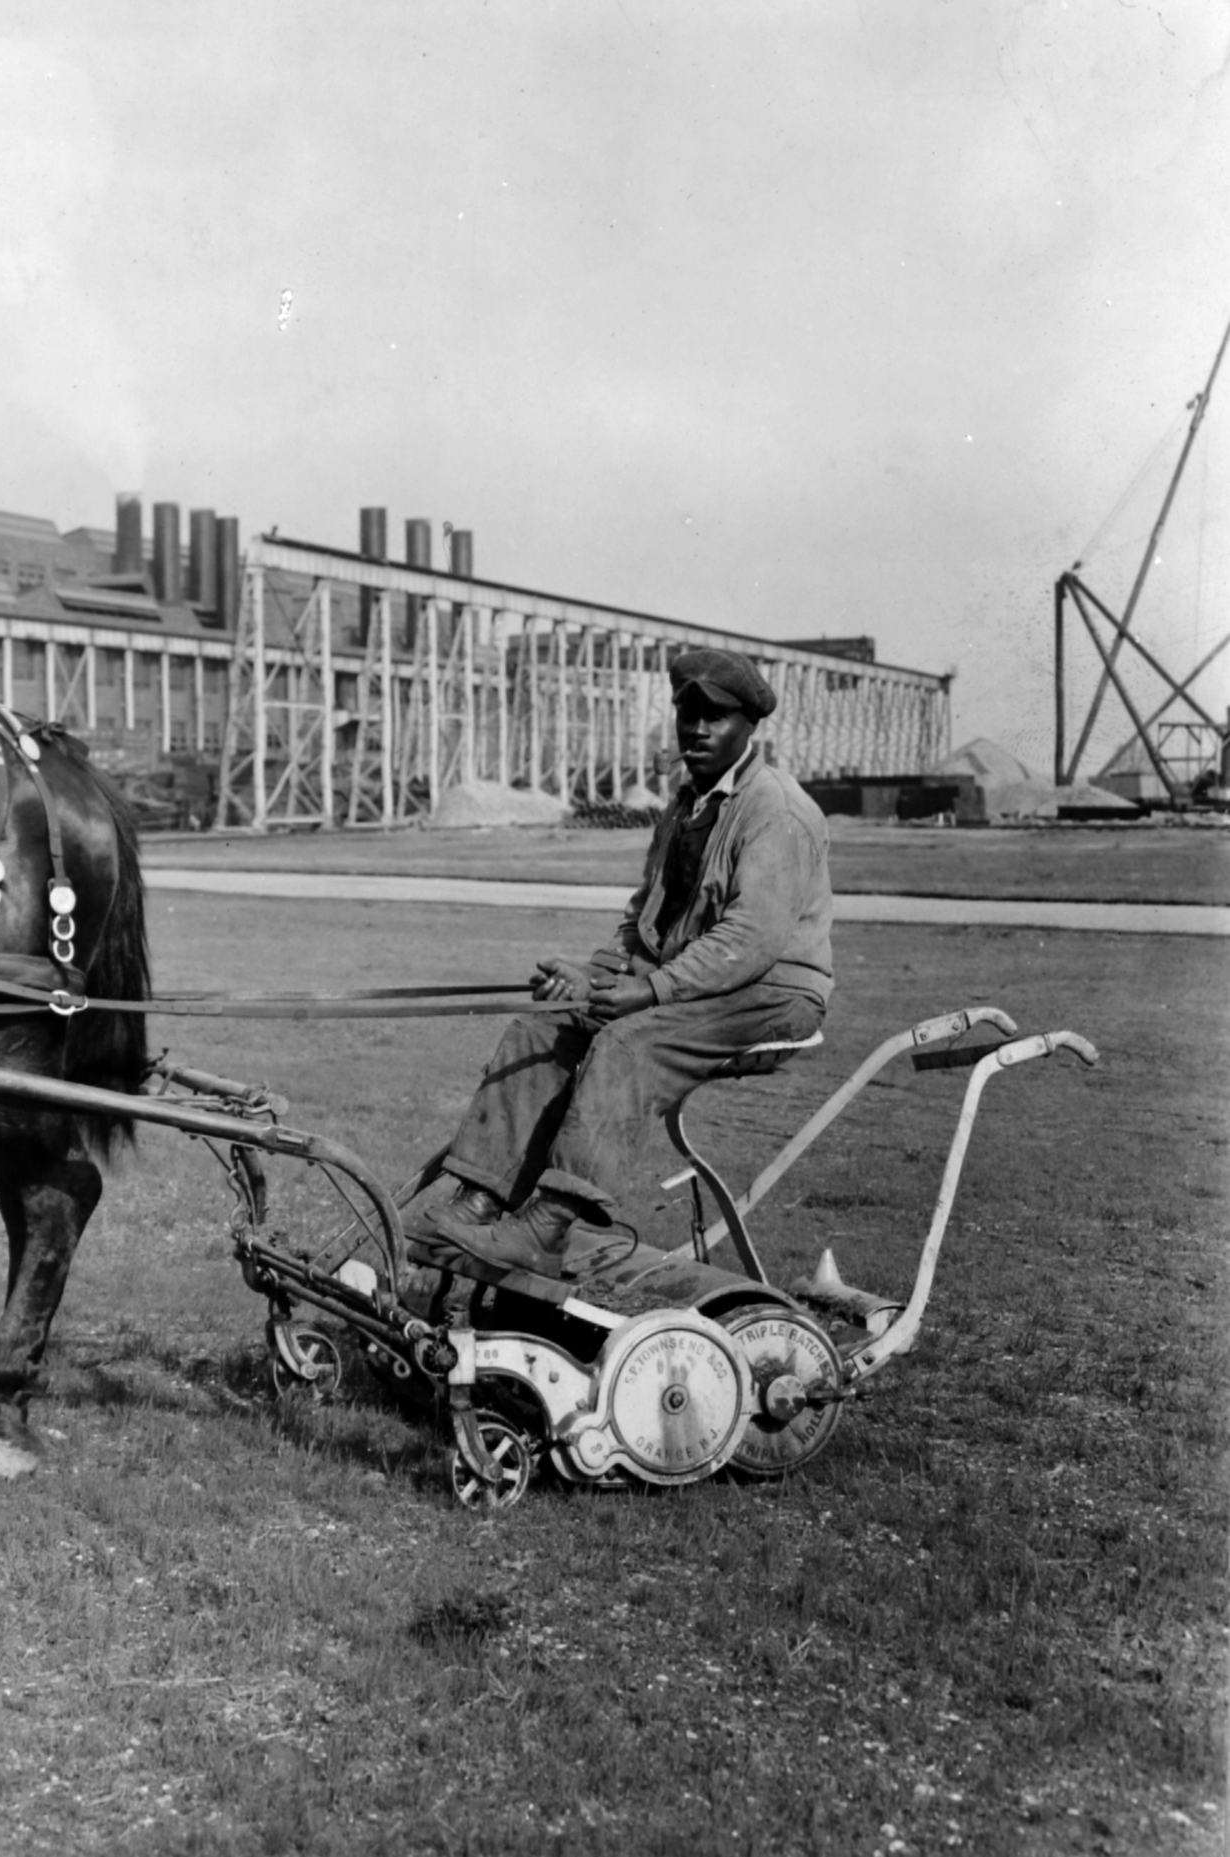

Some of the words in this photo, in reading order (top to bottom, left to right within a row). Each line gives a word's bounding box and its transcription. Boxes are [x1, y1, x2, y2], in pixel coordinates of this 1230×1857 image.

[738, 1324, 785, 1346] TRIPLE
[788, 1328, 835, 1378] RATCHET
[635, 1436, 694, 1462] ORANGE
